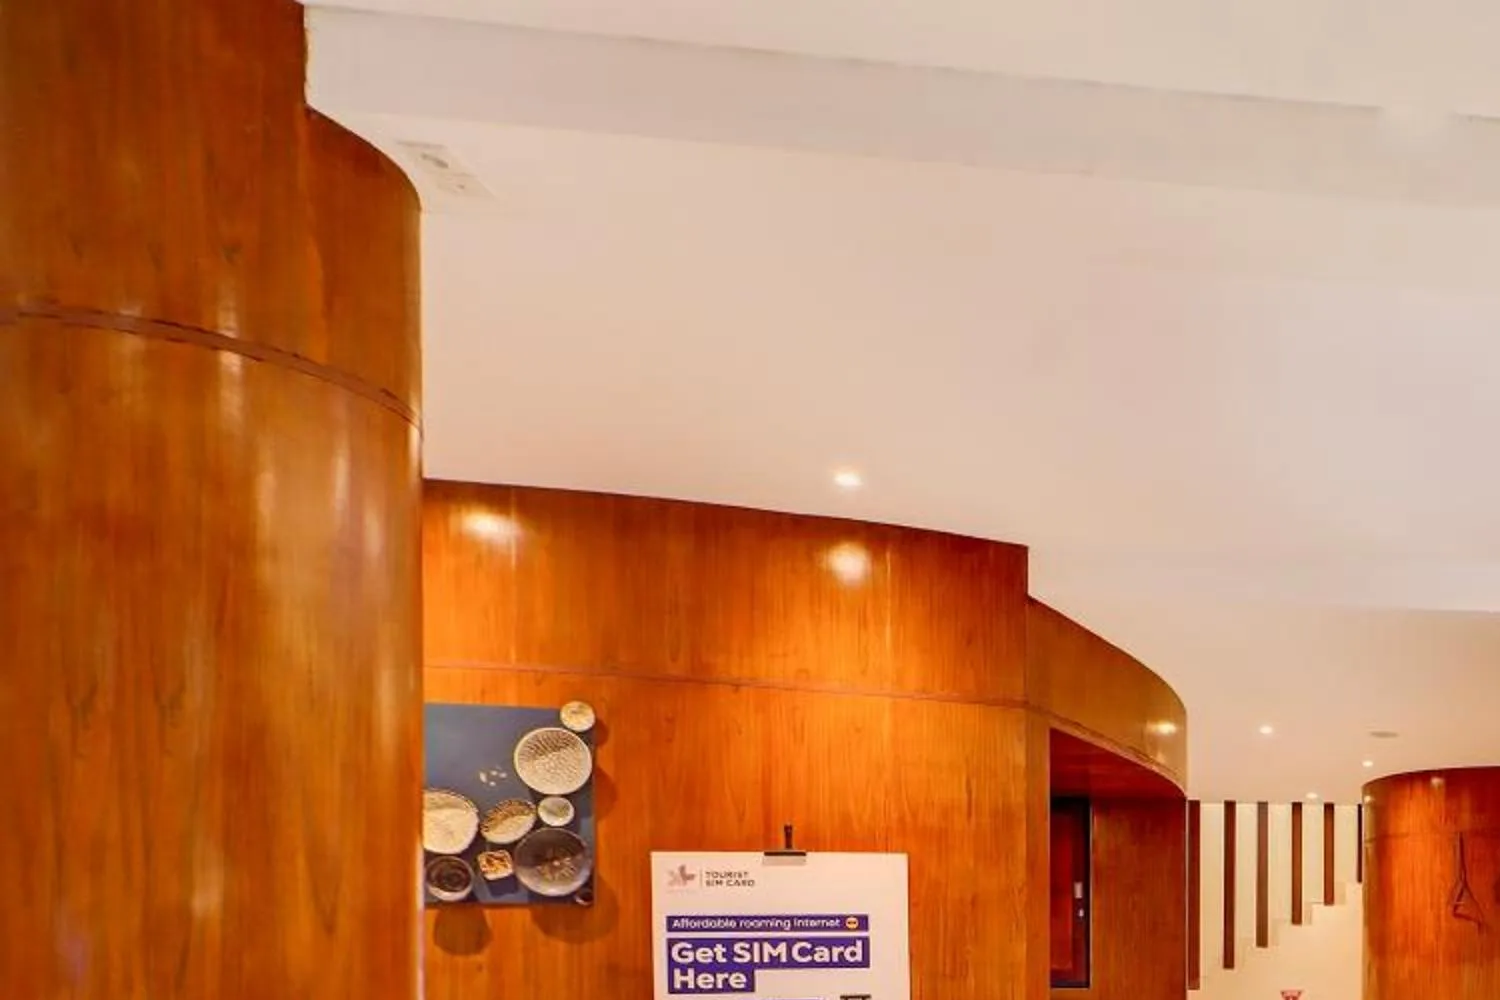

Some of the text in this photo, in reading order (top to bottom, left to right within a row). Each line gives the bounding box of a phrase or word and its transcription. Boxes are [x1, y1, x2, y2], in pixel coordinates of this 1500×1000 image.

[705, 871, 748, 879] TOURIST
[672, 918, 737, 929] Affordable
[739, 918, 791, 930] roaming
[671, 939, 863, 963] Get SIM Card
[673, 968, 747, 989] Here
